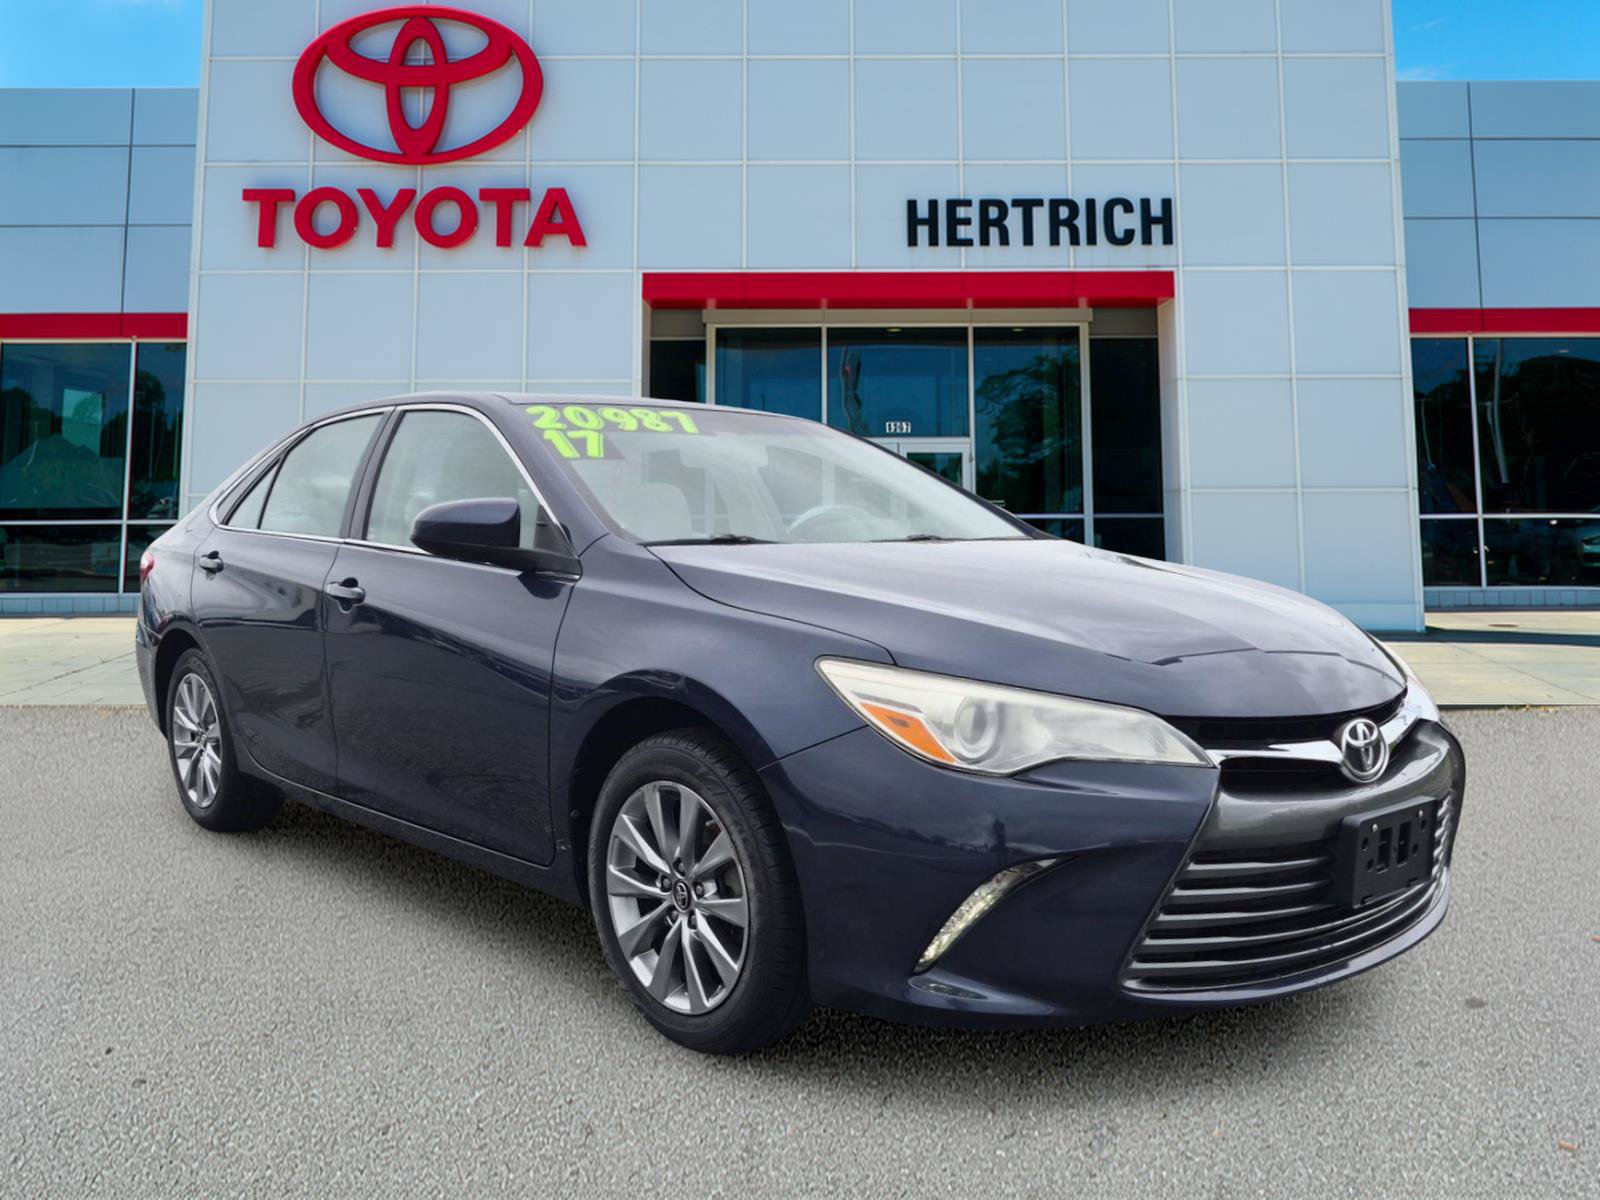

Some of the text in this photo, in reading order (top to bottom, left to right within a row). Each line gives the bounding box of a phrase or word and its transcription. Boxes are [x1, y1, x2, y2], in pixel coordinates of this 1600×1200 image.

[242, 186, 588, 250] TOYOTA
[907, 198, 1174, 247] HERTRICH
[526, 405, 699, 434] 20987
[543, 429, 604, 458] 17
